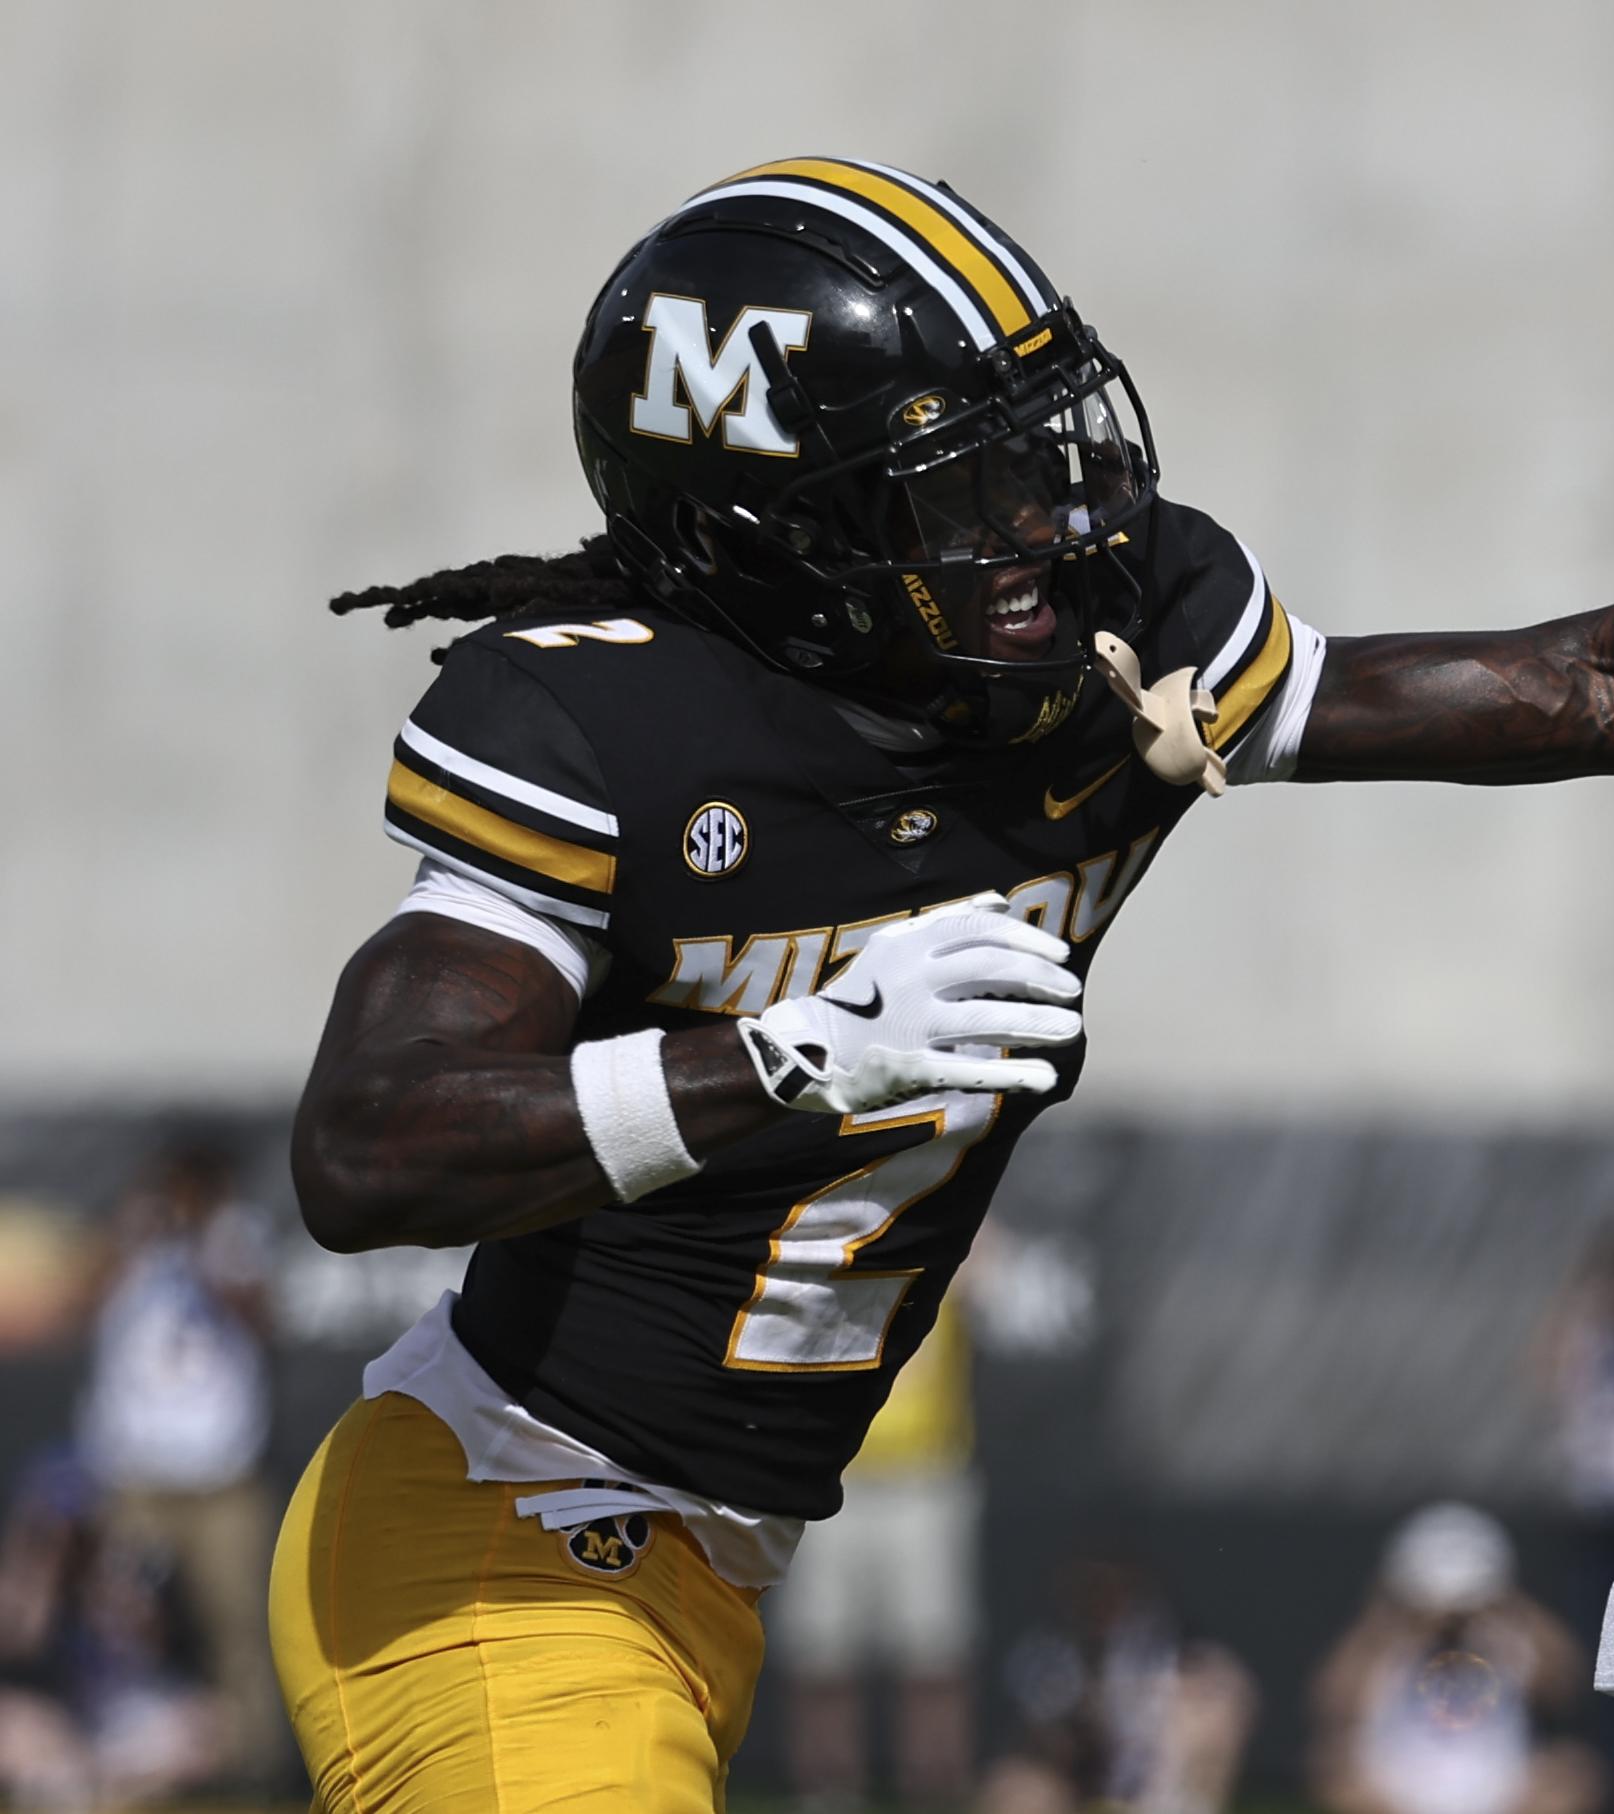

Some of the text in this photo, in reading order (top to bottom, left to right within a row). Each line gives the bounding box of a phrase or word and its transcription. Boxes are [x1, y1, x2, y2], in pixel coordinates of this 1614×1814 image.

[629, 292, 813, 458] M
[503, 617, 655, 648] 2
[689, 807, 744, 874] SEC
[722, 1040, 1011, 1372] 2
[581, 1530, 623, 1567] M
